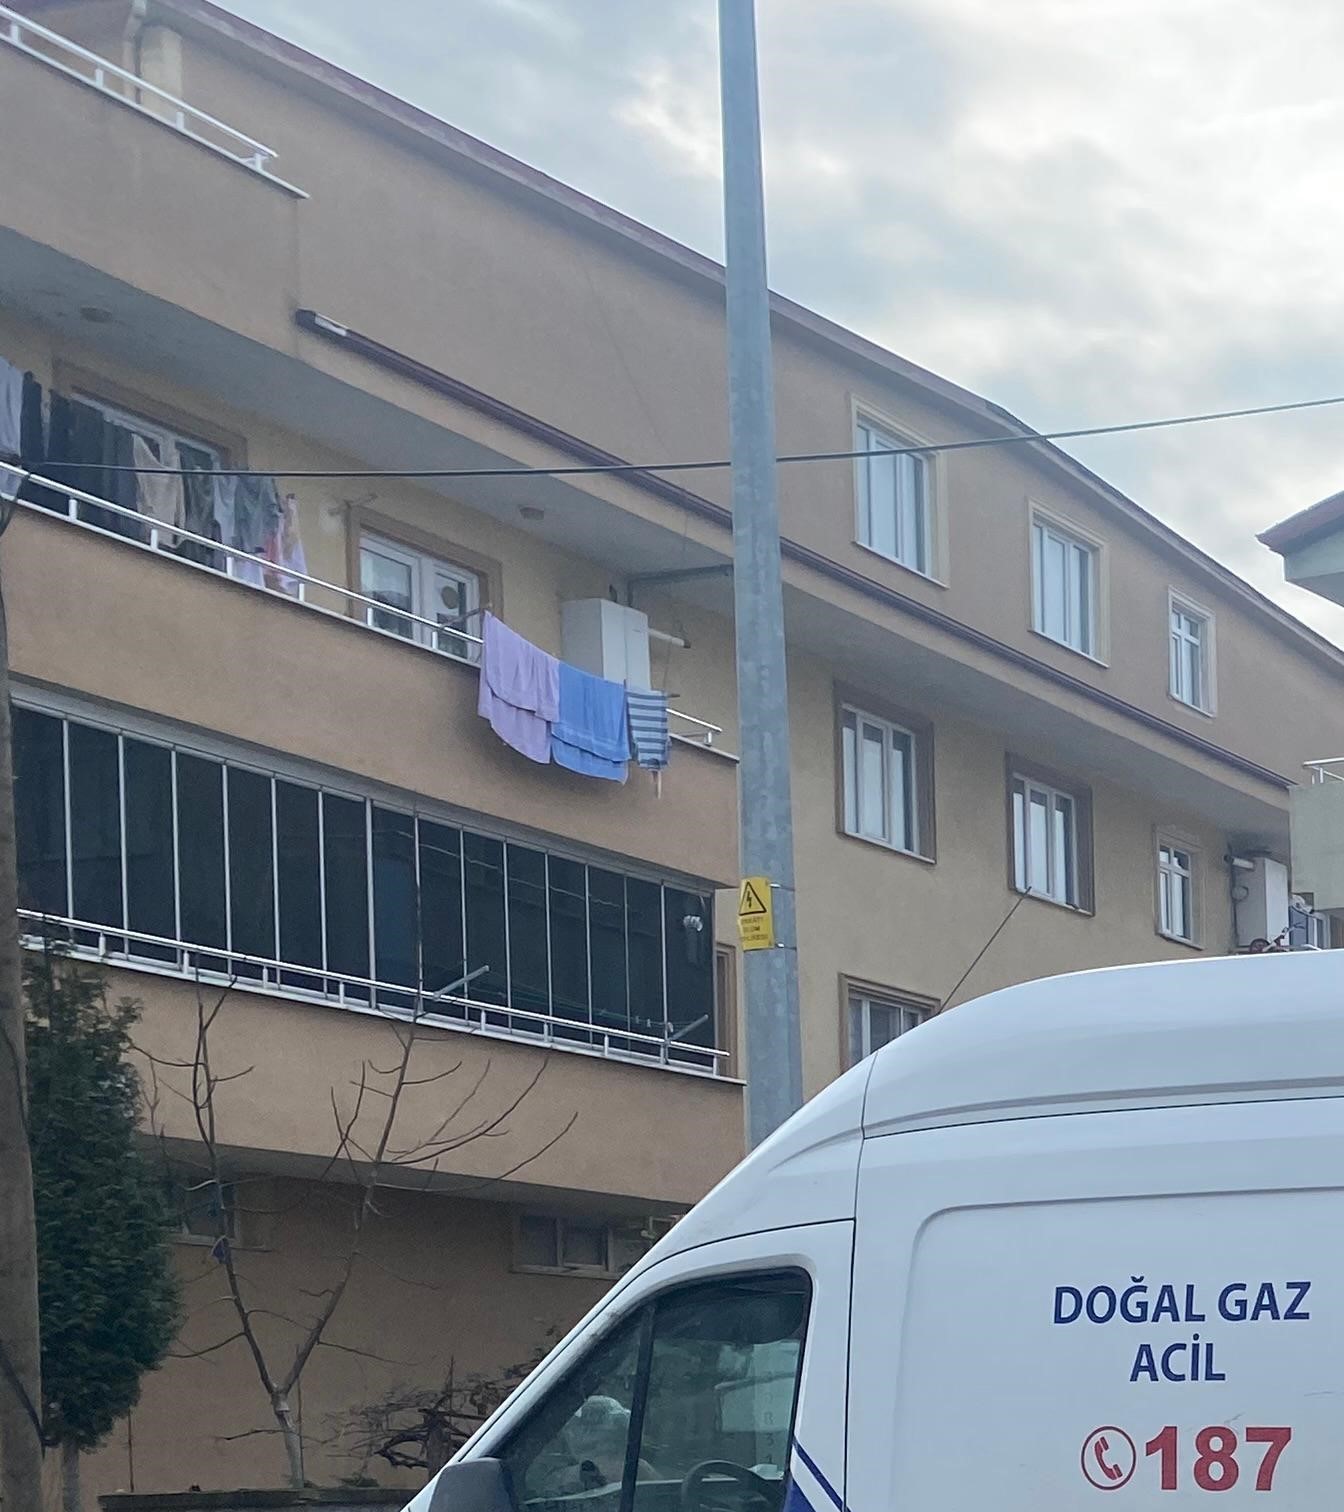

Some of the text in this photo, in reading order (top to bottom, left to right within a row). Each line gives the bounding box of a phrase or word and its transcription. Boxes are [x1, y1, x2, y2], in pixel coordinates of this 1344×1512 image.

[1053, 1275, 1312, 1324] DOĞAL GAZ
[1129, 1333, 1226, 1382] ACİL
[1145, 1425, 1292, 1491] 187
